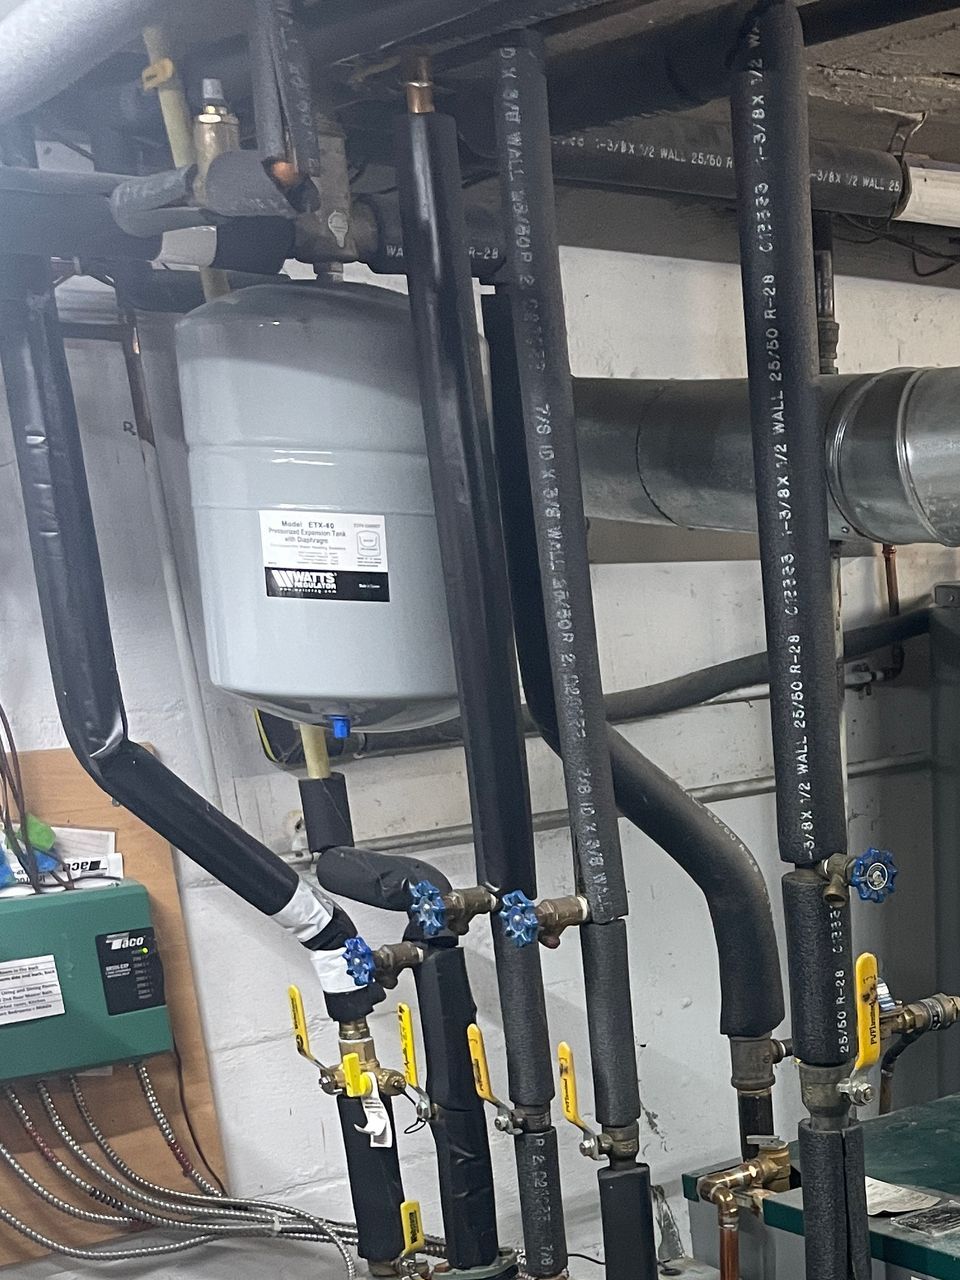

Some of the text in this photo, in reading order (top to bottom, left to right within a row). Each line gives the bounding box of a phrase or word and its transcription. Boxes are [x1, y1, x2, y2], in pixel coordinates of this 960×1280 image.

[660, 147, 686, 163] WALL
[763, 274, 777, 319] R-28
[771, 391, 785, 435] WALL
[292, 570, 336, 583] WATTS
[294, 581, 337, 590] REGULATOR
[796, 735, 809, 775] WALL
